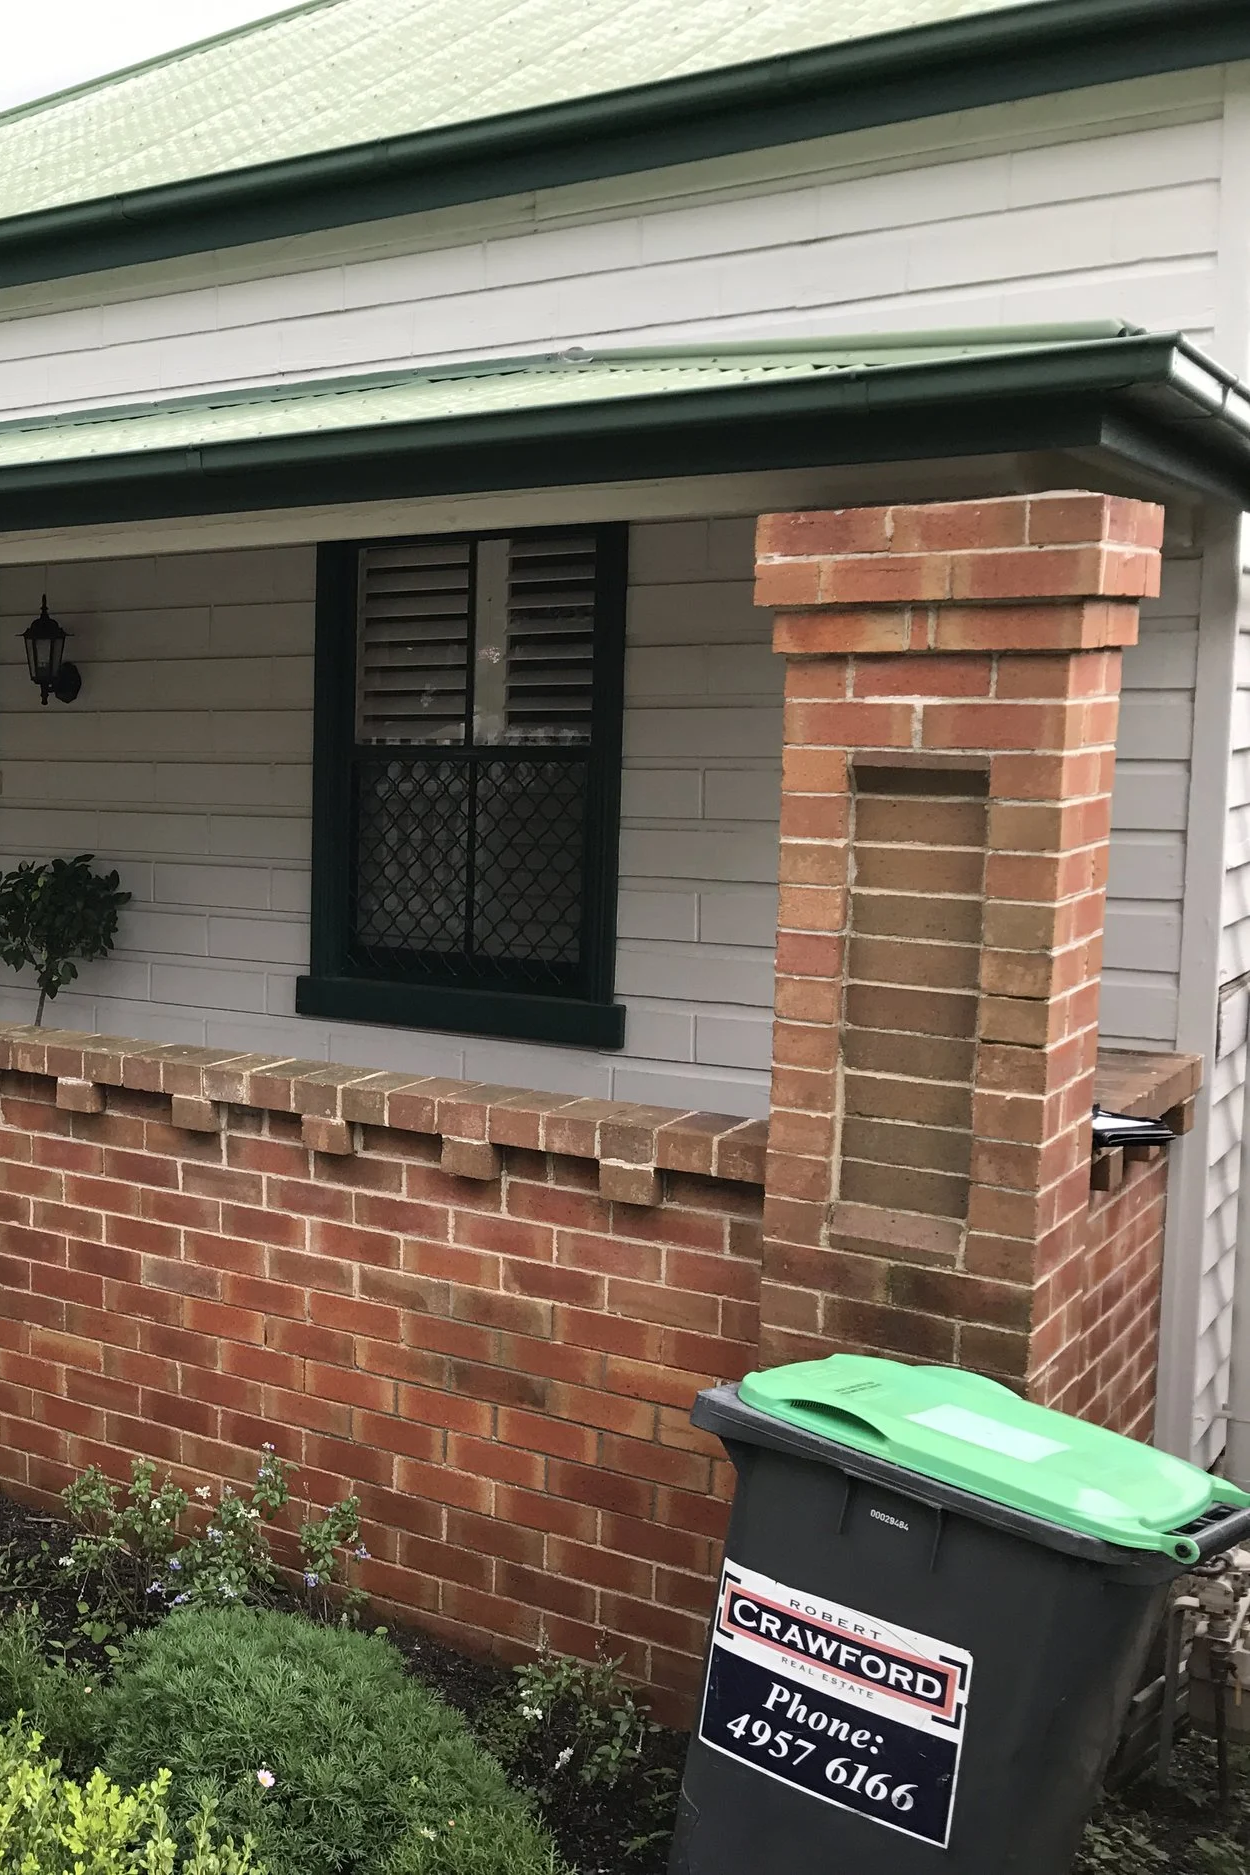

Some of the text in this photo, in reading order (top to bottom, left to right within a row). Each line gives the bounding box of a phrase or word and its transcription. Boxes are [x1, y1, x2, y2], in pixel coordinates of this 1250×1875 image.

[733, 1599, 943, 1699] CRAWFORD
[790, 1599, 882, 1640] ROBERT
[781, 1656, 875, 1699] REAL ESTATE
[762, 1682, 884, 1755] Phone:
[726, 1713, 919, 1811] 4957 6166
